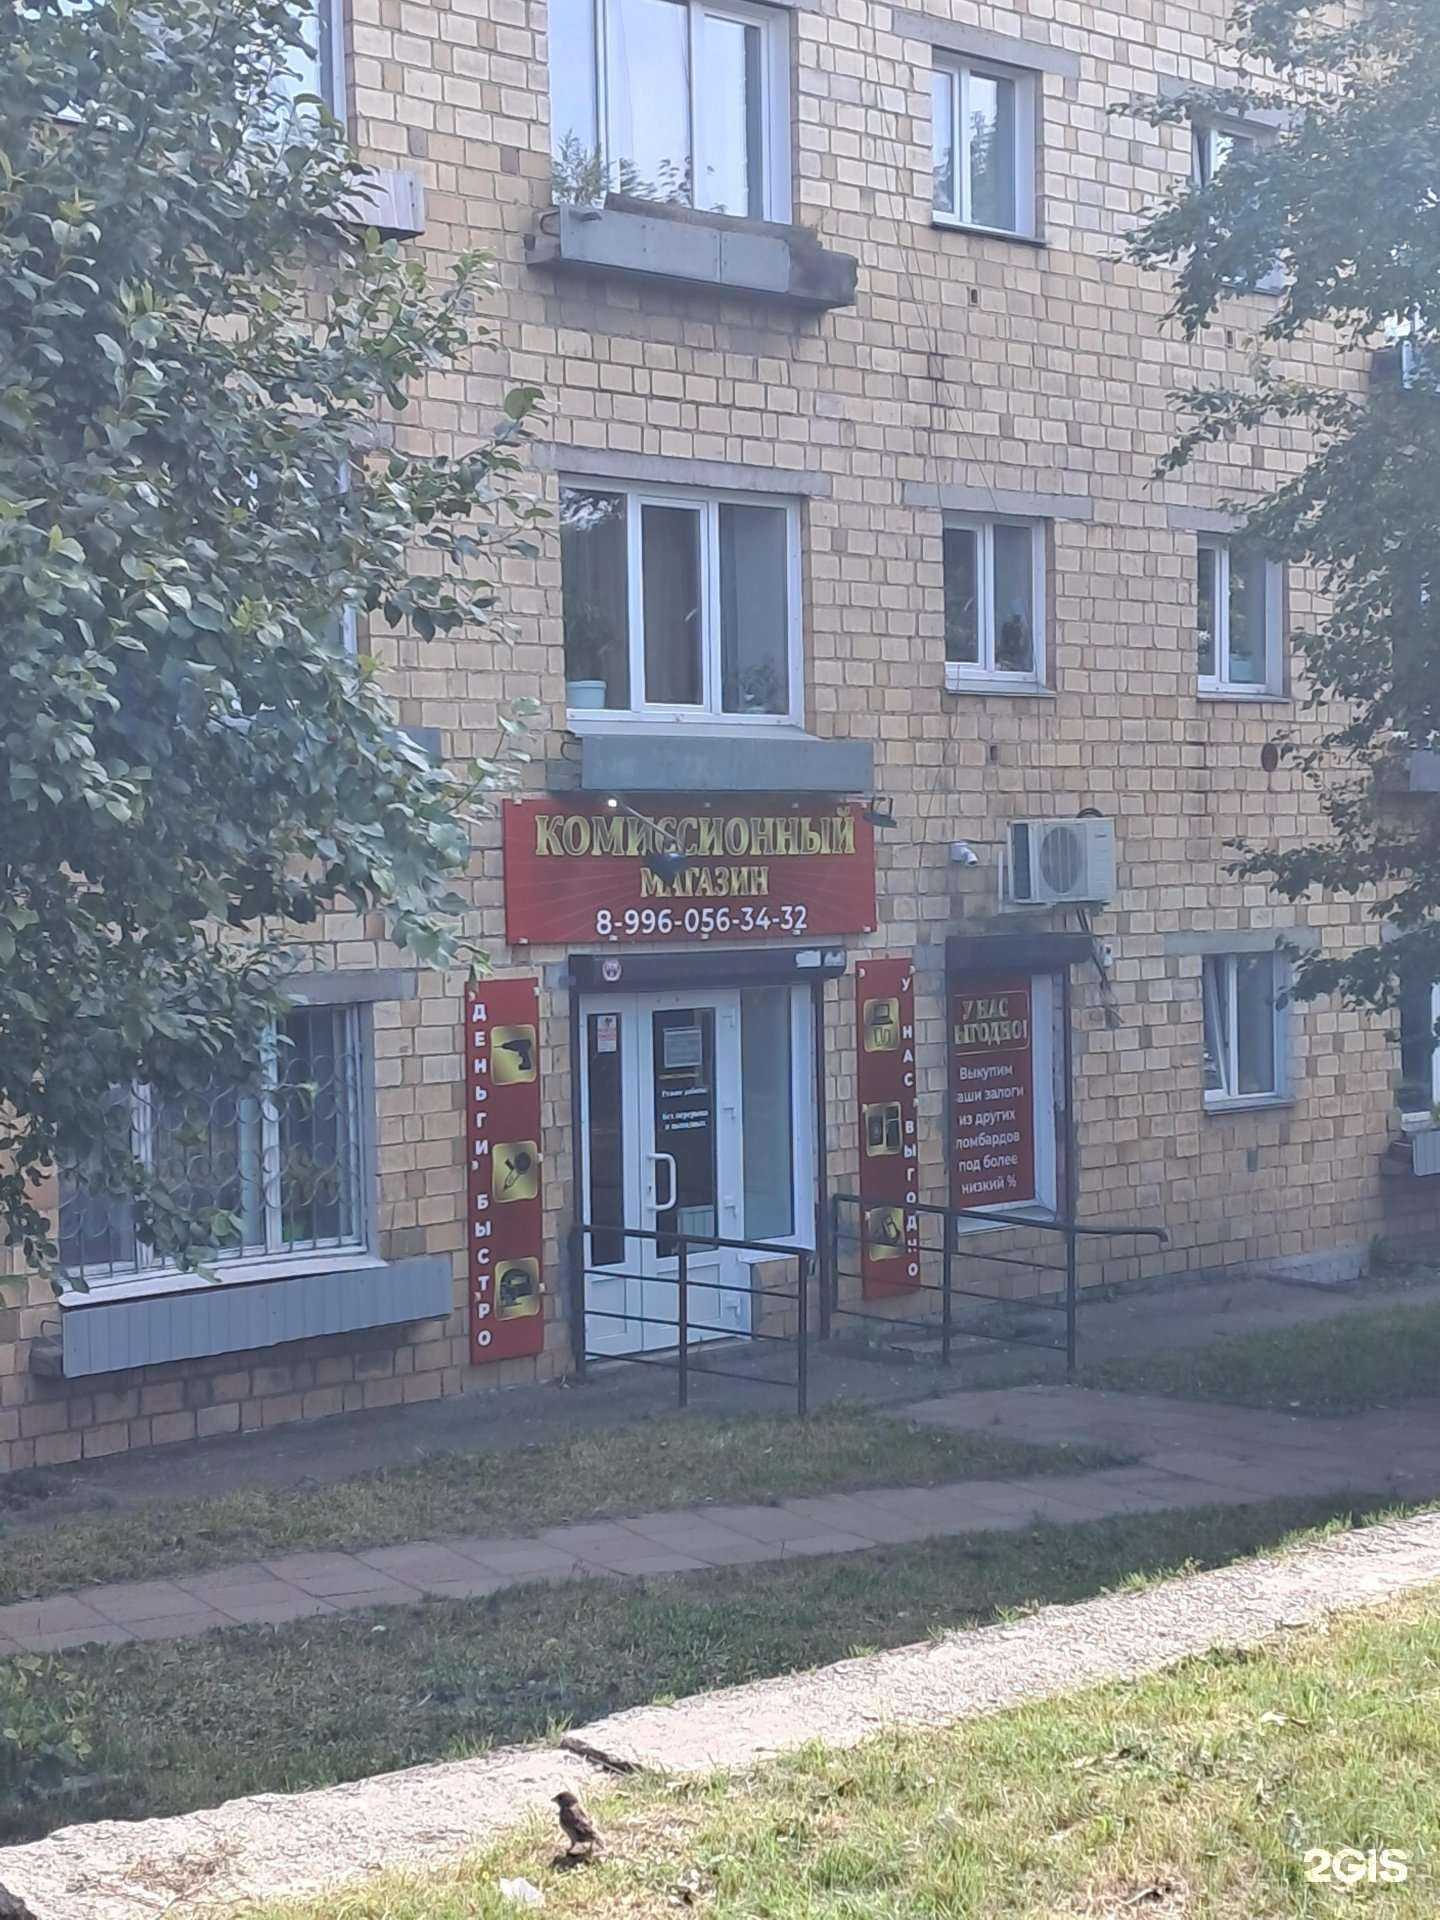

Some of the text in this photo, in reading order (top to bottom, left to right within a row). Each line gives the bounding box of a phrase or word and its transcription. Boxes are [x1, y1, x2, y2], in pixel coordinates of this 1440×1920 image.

[535, 806, 856, 856] КОМИССИОННЫЙ
[640, 865, 769, 898] МАГАЗИН
[596, 906, 808, 935] 8-996-056-34-32
[954, 1019, 1028, 1046] ЫГОДНО!
[959, 1065, 1014, 1081] Выкупим
[956, 1086, 1024, 1104] аши залоги
[901, 977, 919, 1277] У НАС ВЫГОДНО
[958, 1110, 1016, 1128] из других
[956, 1131, 1021, 1150] ломбардов
[472, 1003, 492, 1347] ДЕНЬГИ БЫСТРО
[958, 1154, 1018, 1173] под более
[961, 1175, 1005, 1195] низкий
